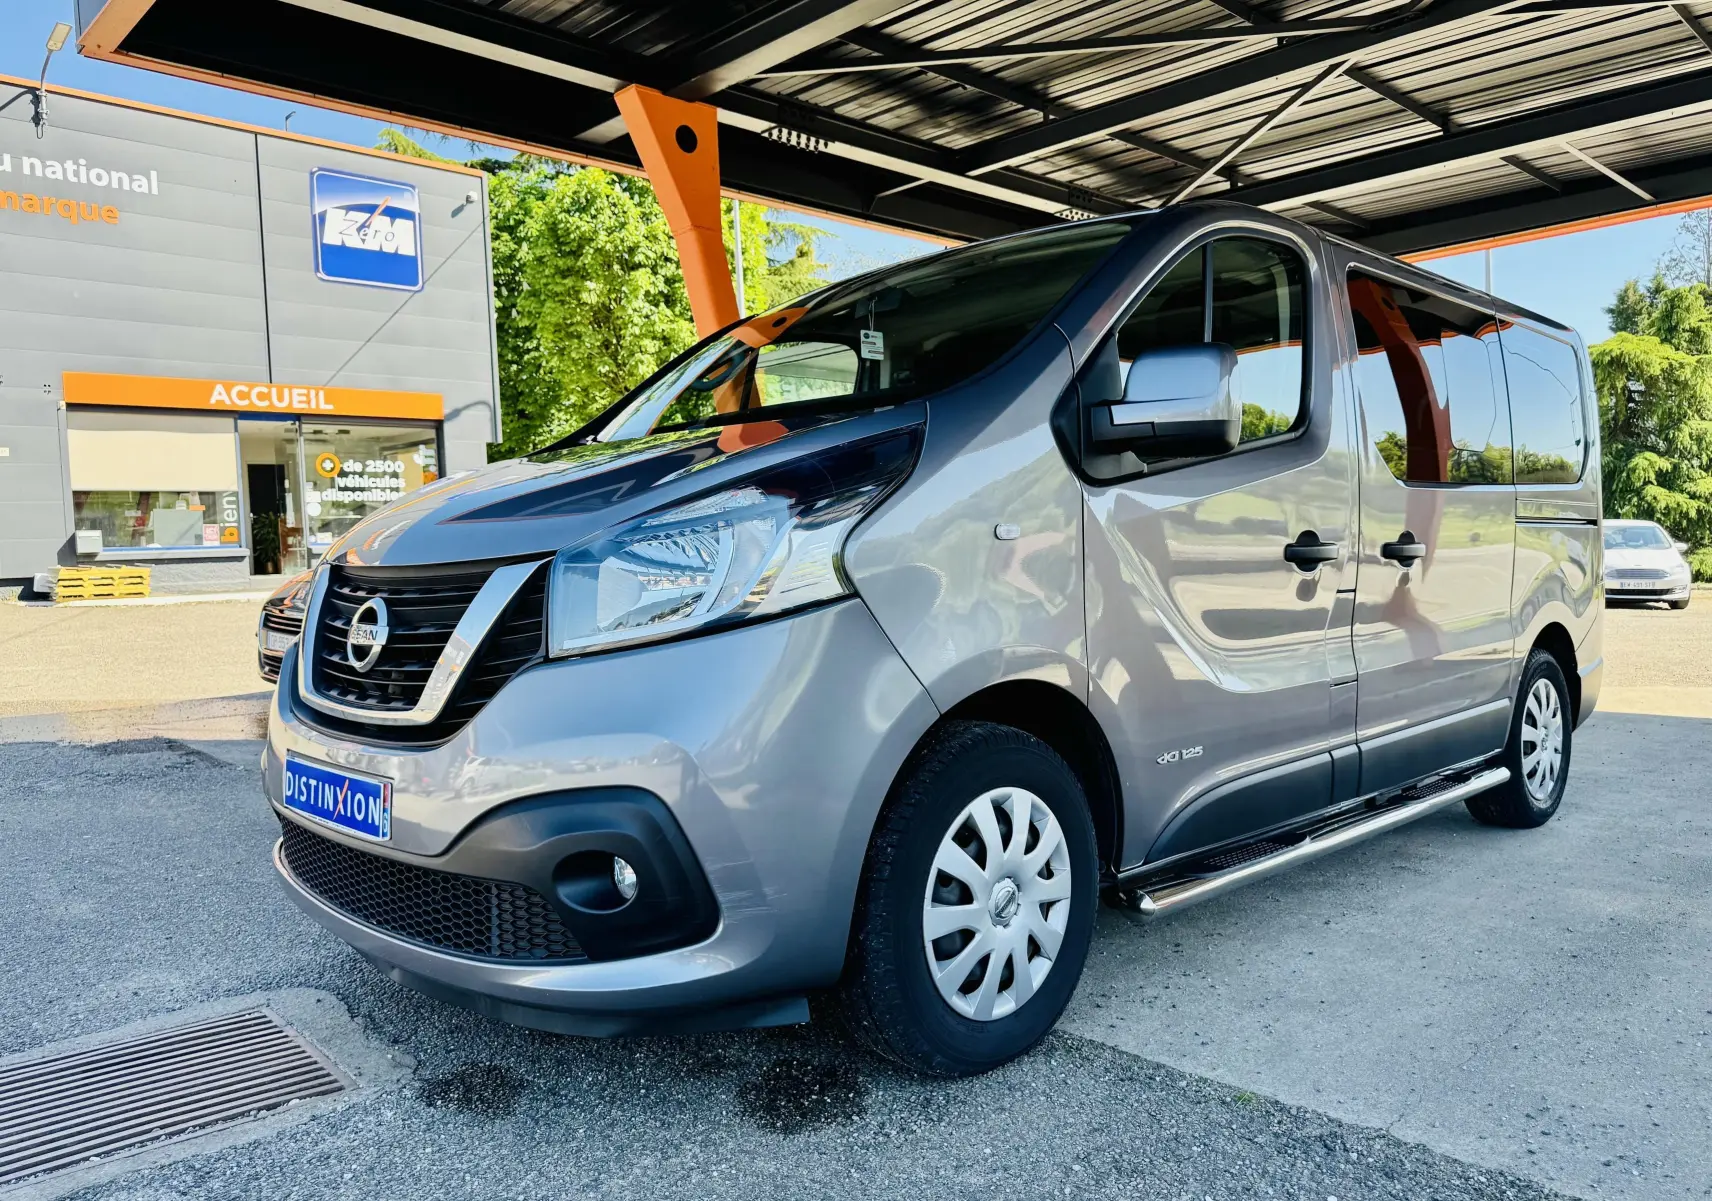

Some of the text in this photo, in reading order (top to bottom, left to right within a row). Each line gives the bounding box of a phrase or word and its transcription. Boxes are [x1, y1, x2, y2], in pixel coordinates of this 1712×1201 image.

[22, 156, 158, 195] national
[210, 384, 334, 409] ACCUEIL
[342, 459, 363, 472] de
[365, 460, 405, 472] 2500
[1181, 745, 1203, 760] 125
[285, 771, 380, 827] DISTINXION
